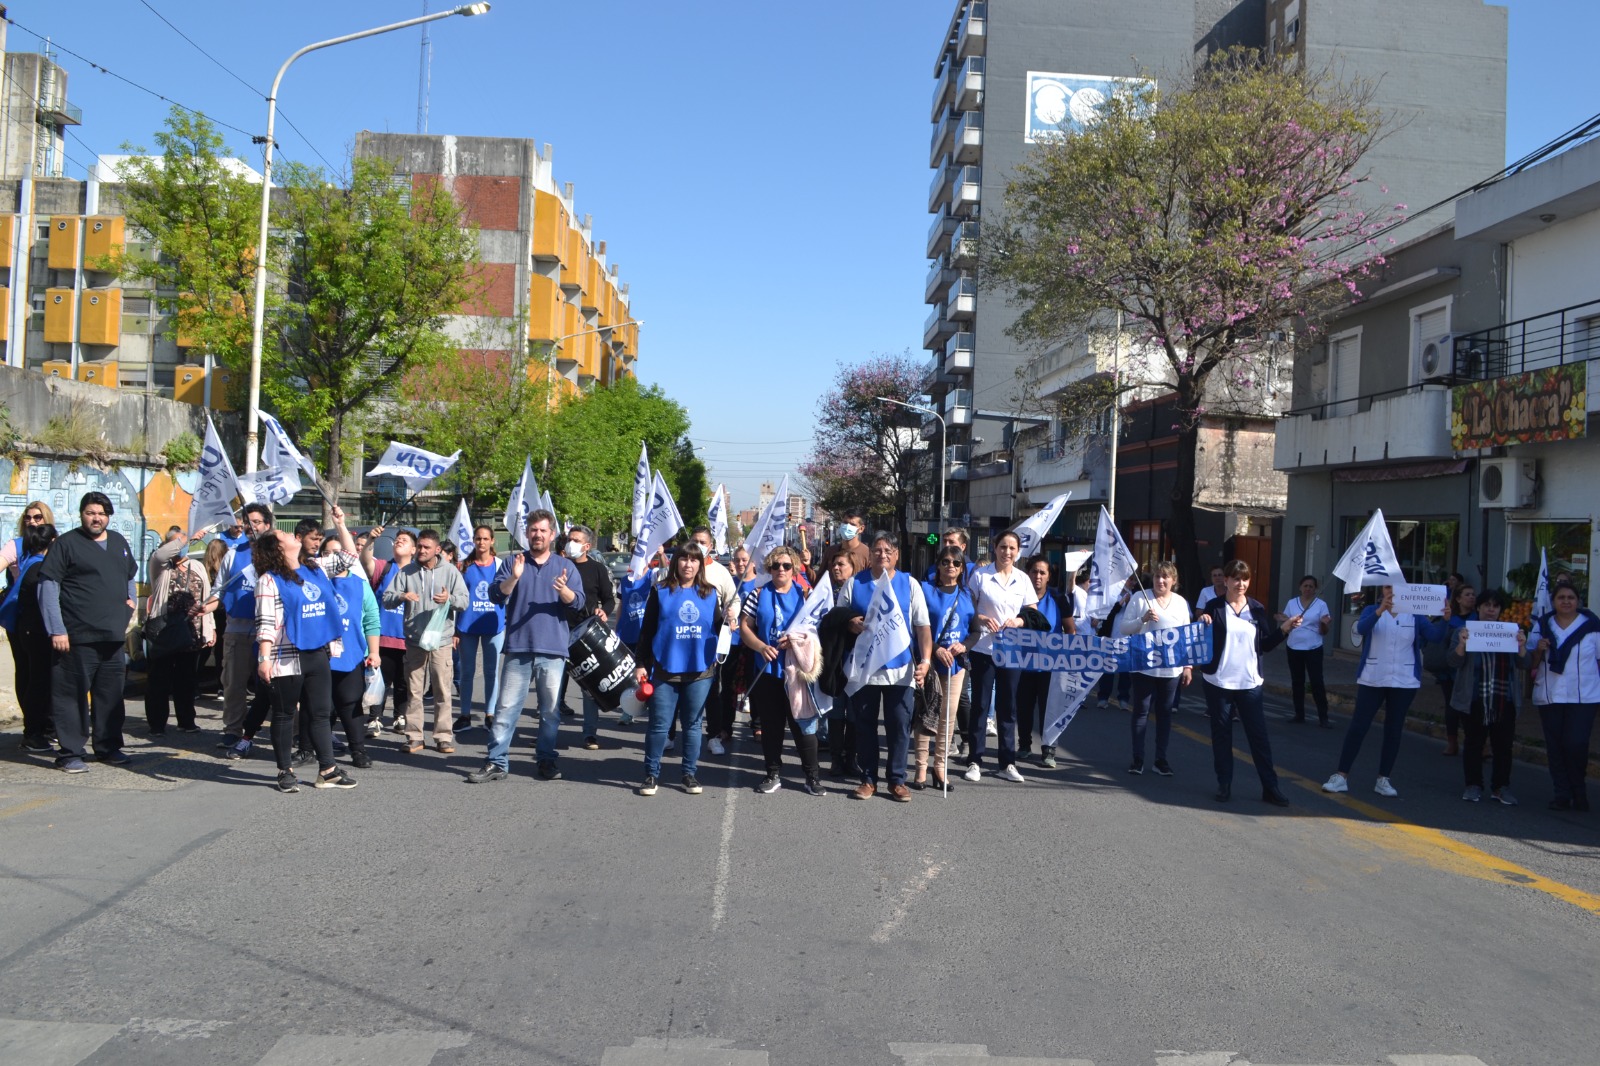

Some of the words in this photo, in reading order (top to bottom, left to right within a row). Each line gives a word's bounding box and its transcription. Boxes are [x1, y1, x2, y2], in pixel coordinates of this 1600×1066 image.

[302, 602, 326, 612] UPCN
[676, 626, 702, 634] UPCN
[1145, 627, 1180, 649] NO
[608, 654, 634, 682] UPCN
[991, 649, 1118, 673] OLVIDADOS
